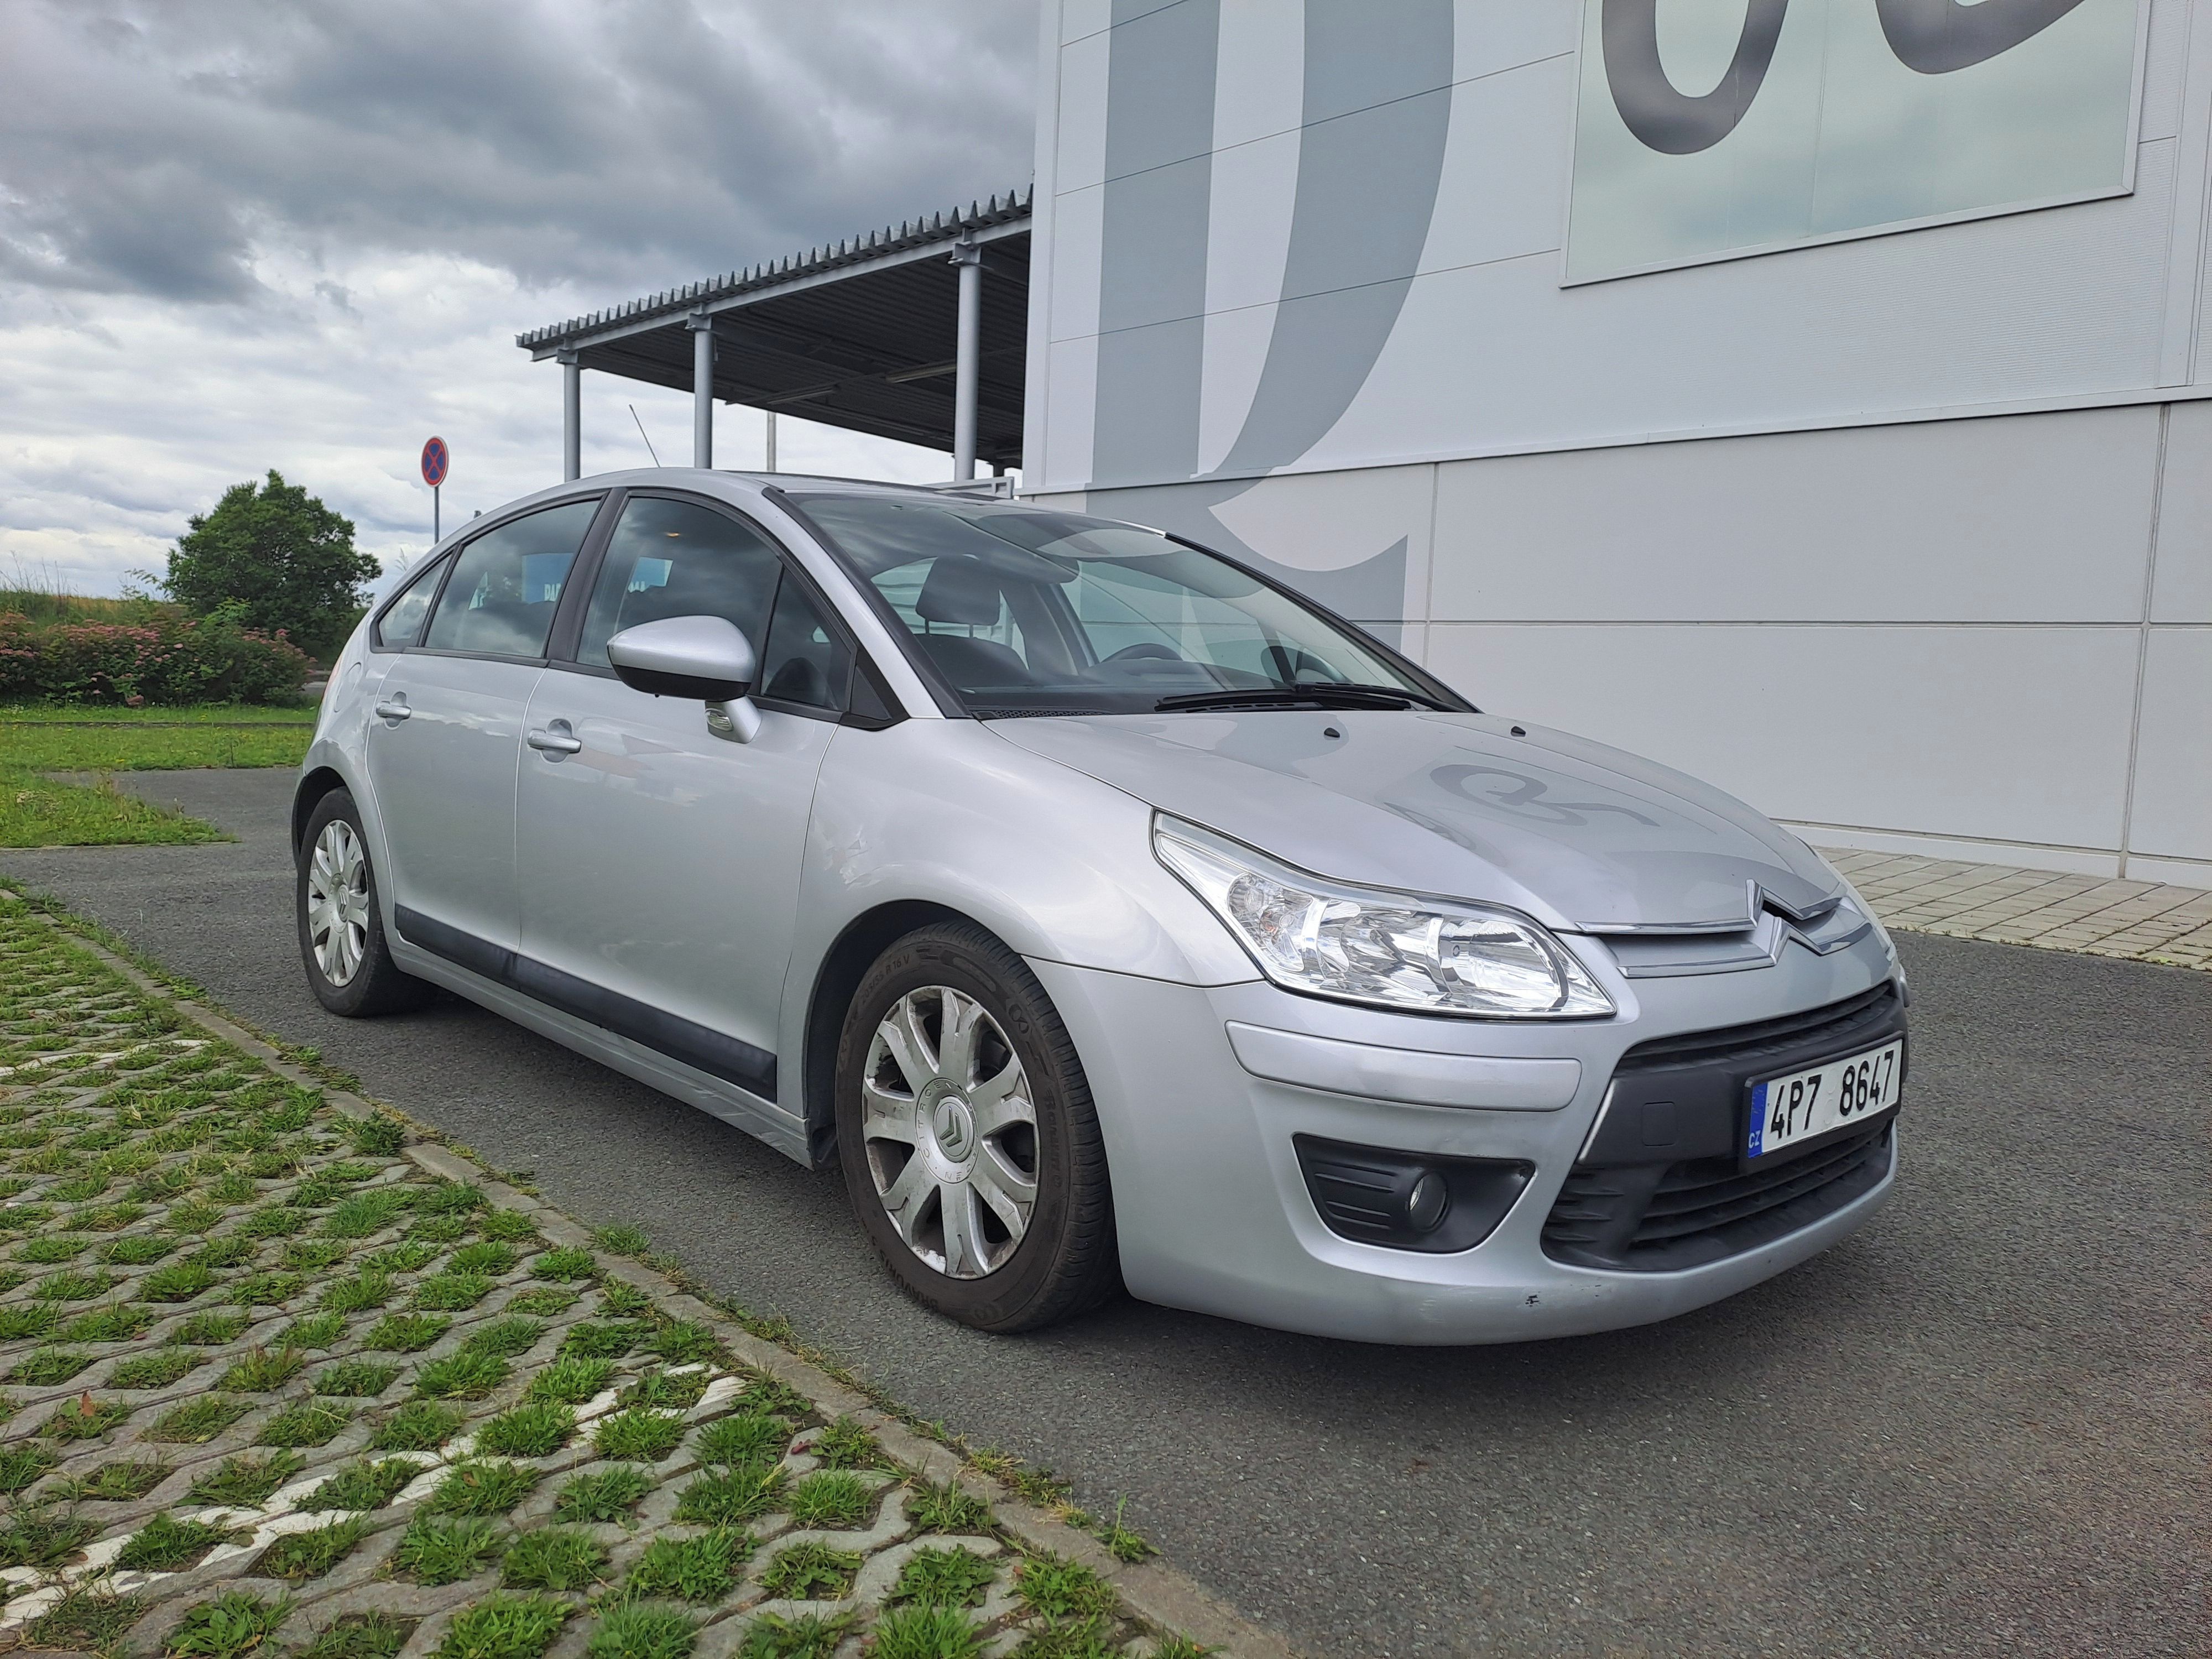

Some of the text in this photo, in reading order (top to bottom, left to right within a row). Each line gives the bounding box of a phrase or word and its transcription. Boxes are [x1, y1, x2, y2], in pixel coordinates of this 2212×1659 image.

[893, 957, 901, 969] 16
[903, 954, 909, 964] V
[1770, 1050, 1894, 1140] 4P7 8647
[1748, 1129, 1761, 1149] CZ
